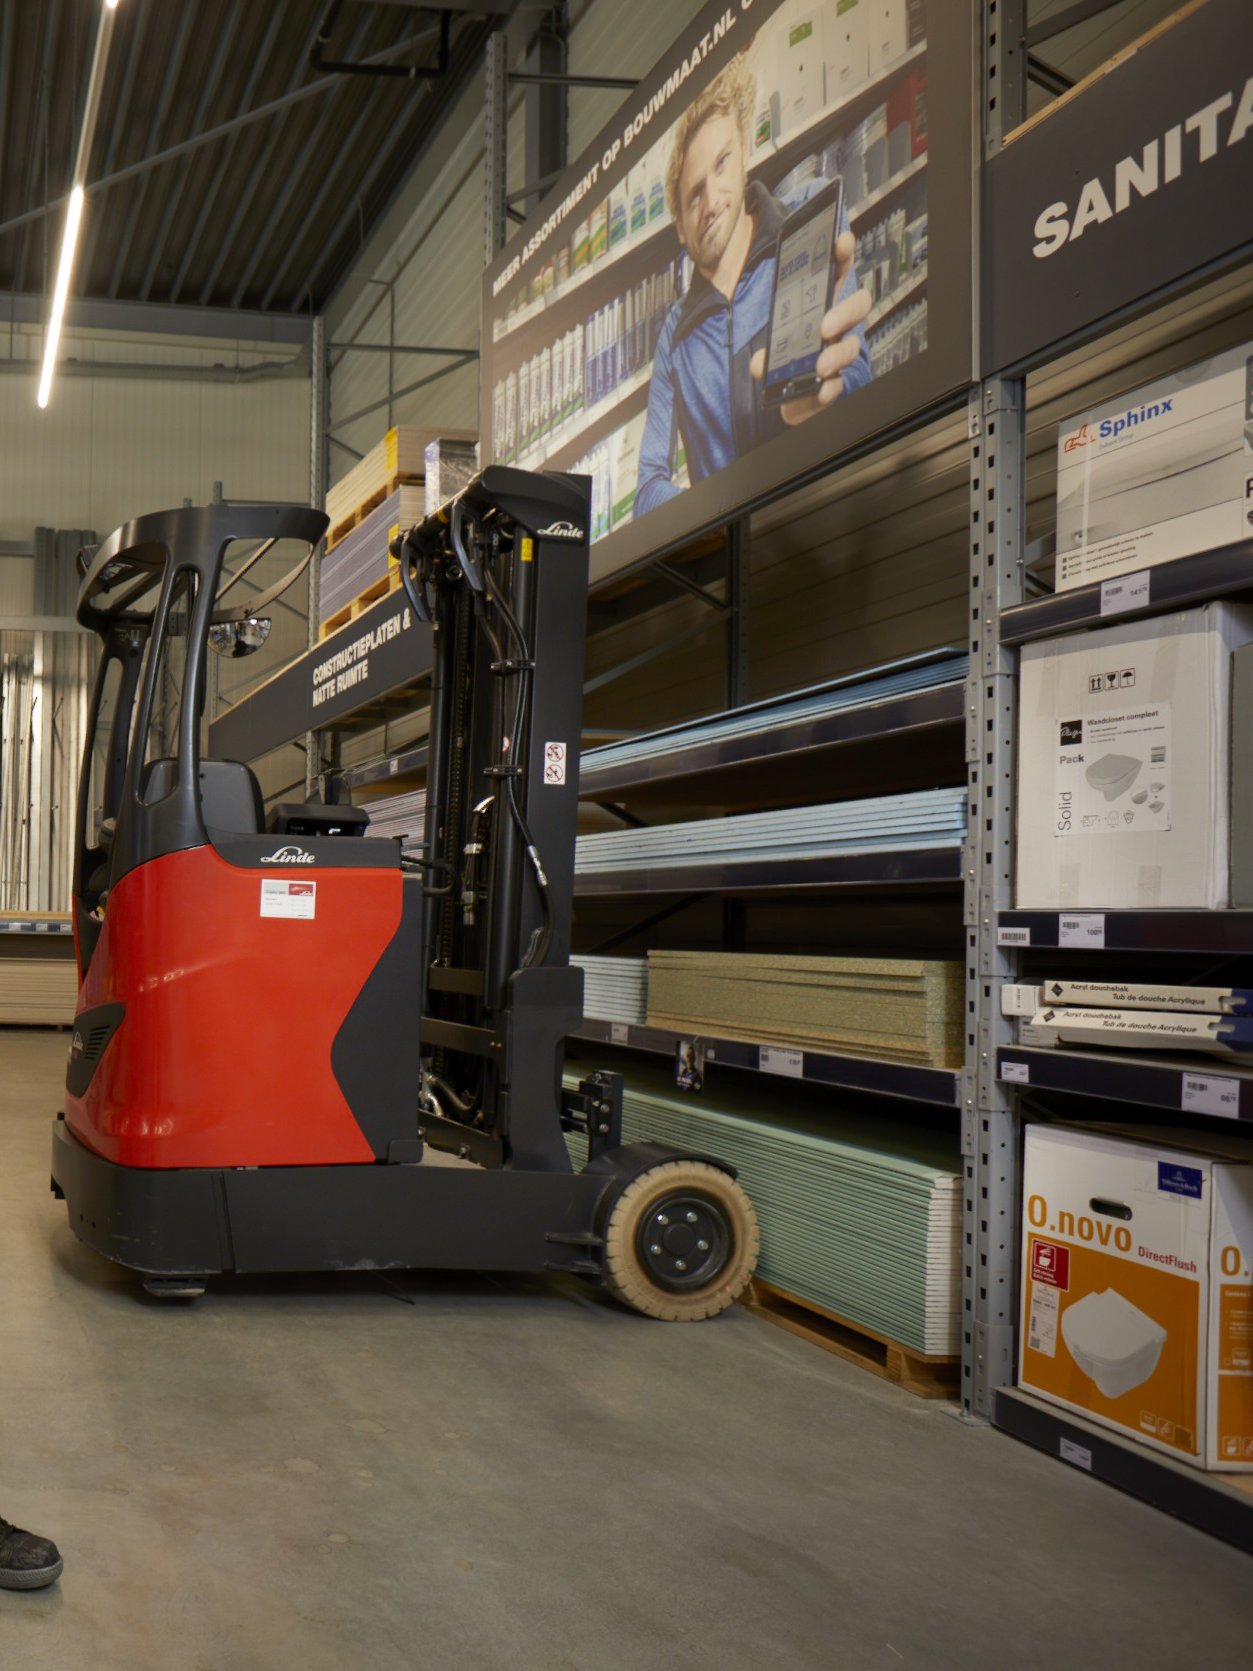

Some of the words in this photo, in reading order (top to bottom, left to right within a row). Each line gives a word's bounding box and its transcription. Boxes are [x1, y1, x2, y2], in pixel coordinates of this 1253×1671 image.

[492, 255, 521, 297] MEER
[522, 162, 600, 265] ASSORTIMENT
[601, 138, 622, 171] OP
[623, 8, 737, 148] BOUWMAAT.NL
[1099, 398, 1173, 439] Sphinx
[537, 520, 584, 539] Linde
[312, 617, 401, 686] CONSTRUCTIEPLATEN
[402, 607, 412, 631] &
[312, 682, 336, 708] NATTE
[336, 659, 369, 694] RUIMTE
[1087, 715, 1125, 726] Wandcloset
[1126, 710, 1159, 721] compleet
[1059, 753, 1085, 765] Pack
[1057, 791, 1073, 831] Solid
[260, 845, 316, 864] Linde
[1070, 983, 1089, 992] Acryl
[1089, 984, 1129, 993] douchebak
[1138, 995, 1167, 1003] douche
[1167, 995, 1206, 1005] Acrylique
[1064, 1011, 1082, 1019] Acryl
[1083, 1011, 1123, 1020] douchebak
[1127, 1022, 1157, 1030] douche
[1158, 1023, 1197, 1033] Acrylique
[1027, 1194, 1133, 1253] O.novo
[1138, 1245, 1197, 1274] DirectFlush
[1220, 1245, 1250, 1277] O.
